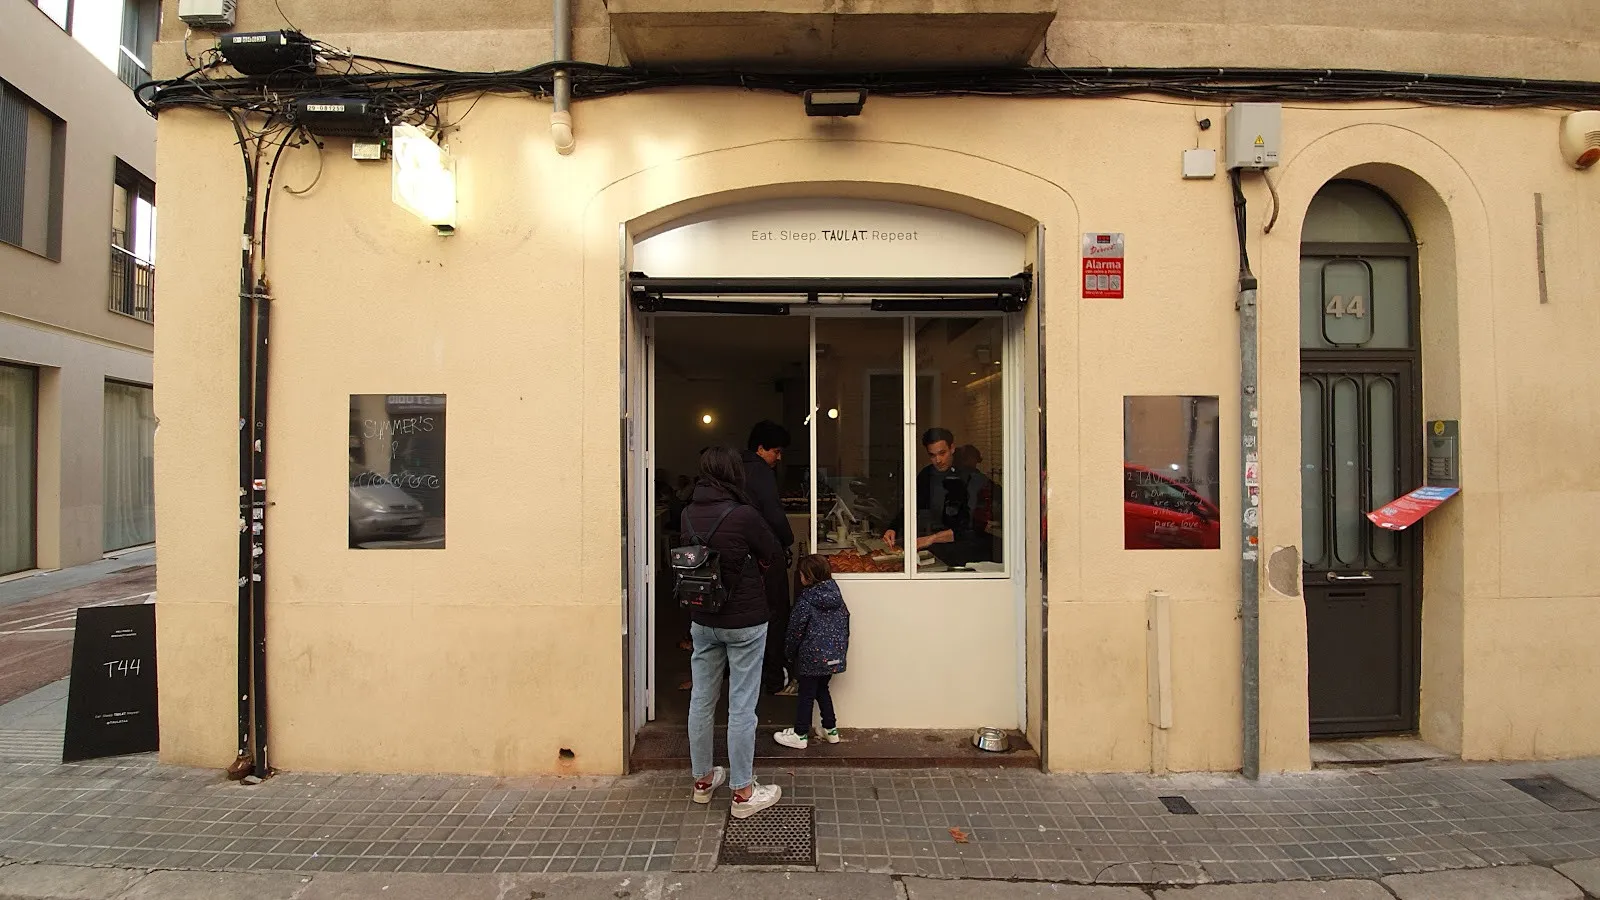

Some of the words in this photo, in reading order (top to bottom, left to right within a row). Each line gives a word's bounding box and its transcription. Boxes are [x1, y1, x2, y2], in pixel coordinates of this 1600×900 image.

[752, 230, 776, 241] Eat.
[780, 230, 820, 243] Sleep.
[872, 230, 918, 243] Repeat
[1085, 259, 1121, 269] Alarma
[1326, 295, 1365, 318] 44
[364, 416, 434, 440] SUMMER'S
[103, 658, 141, 678] T44
